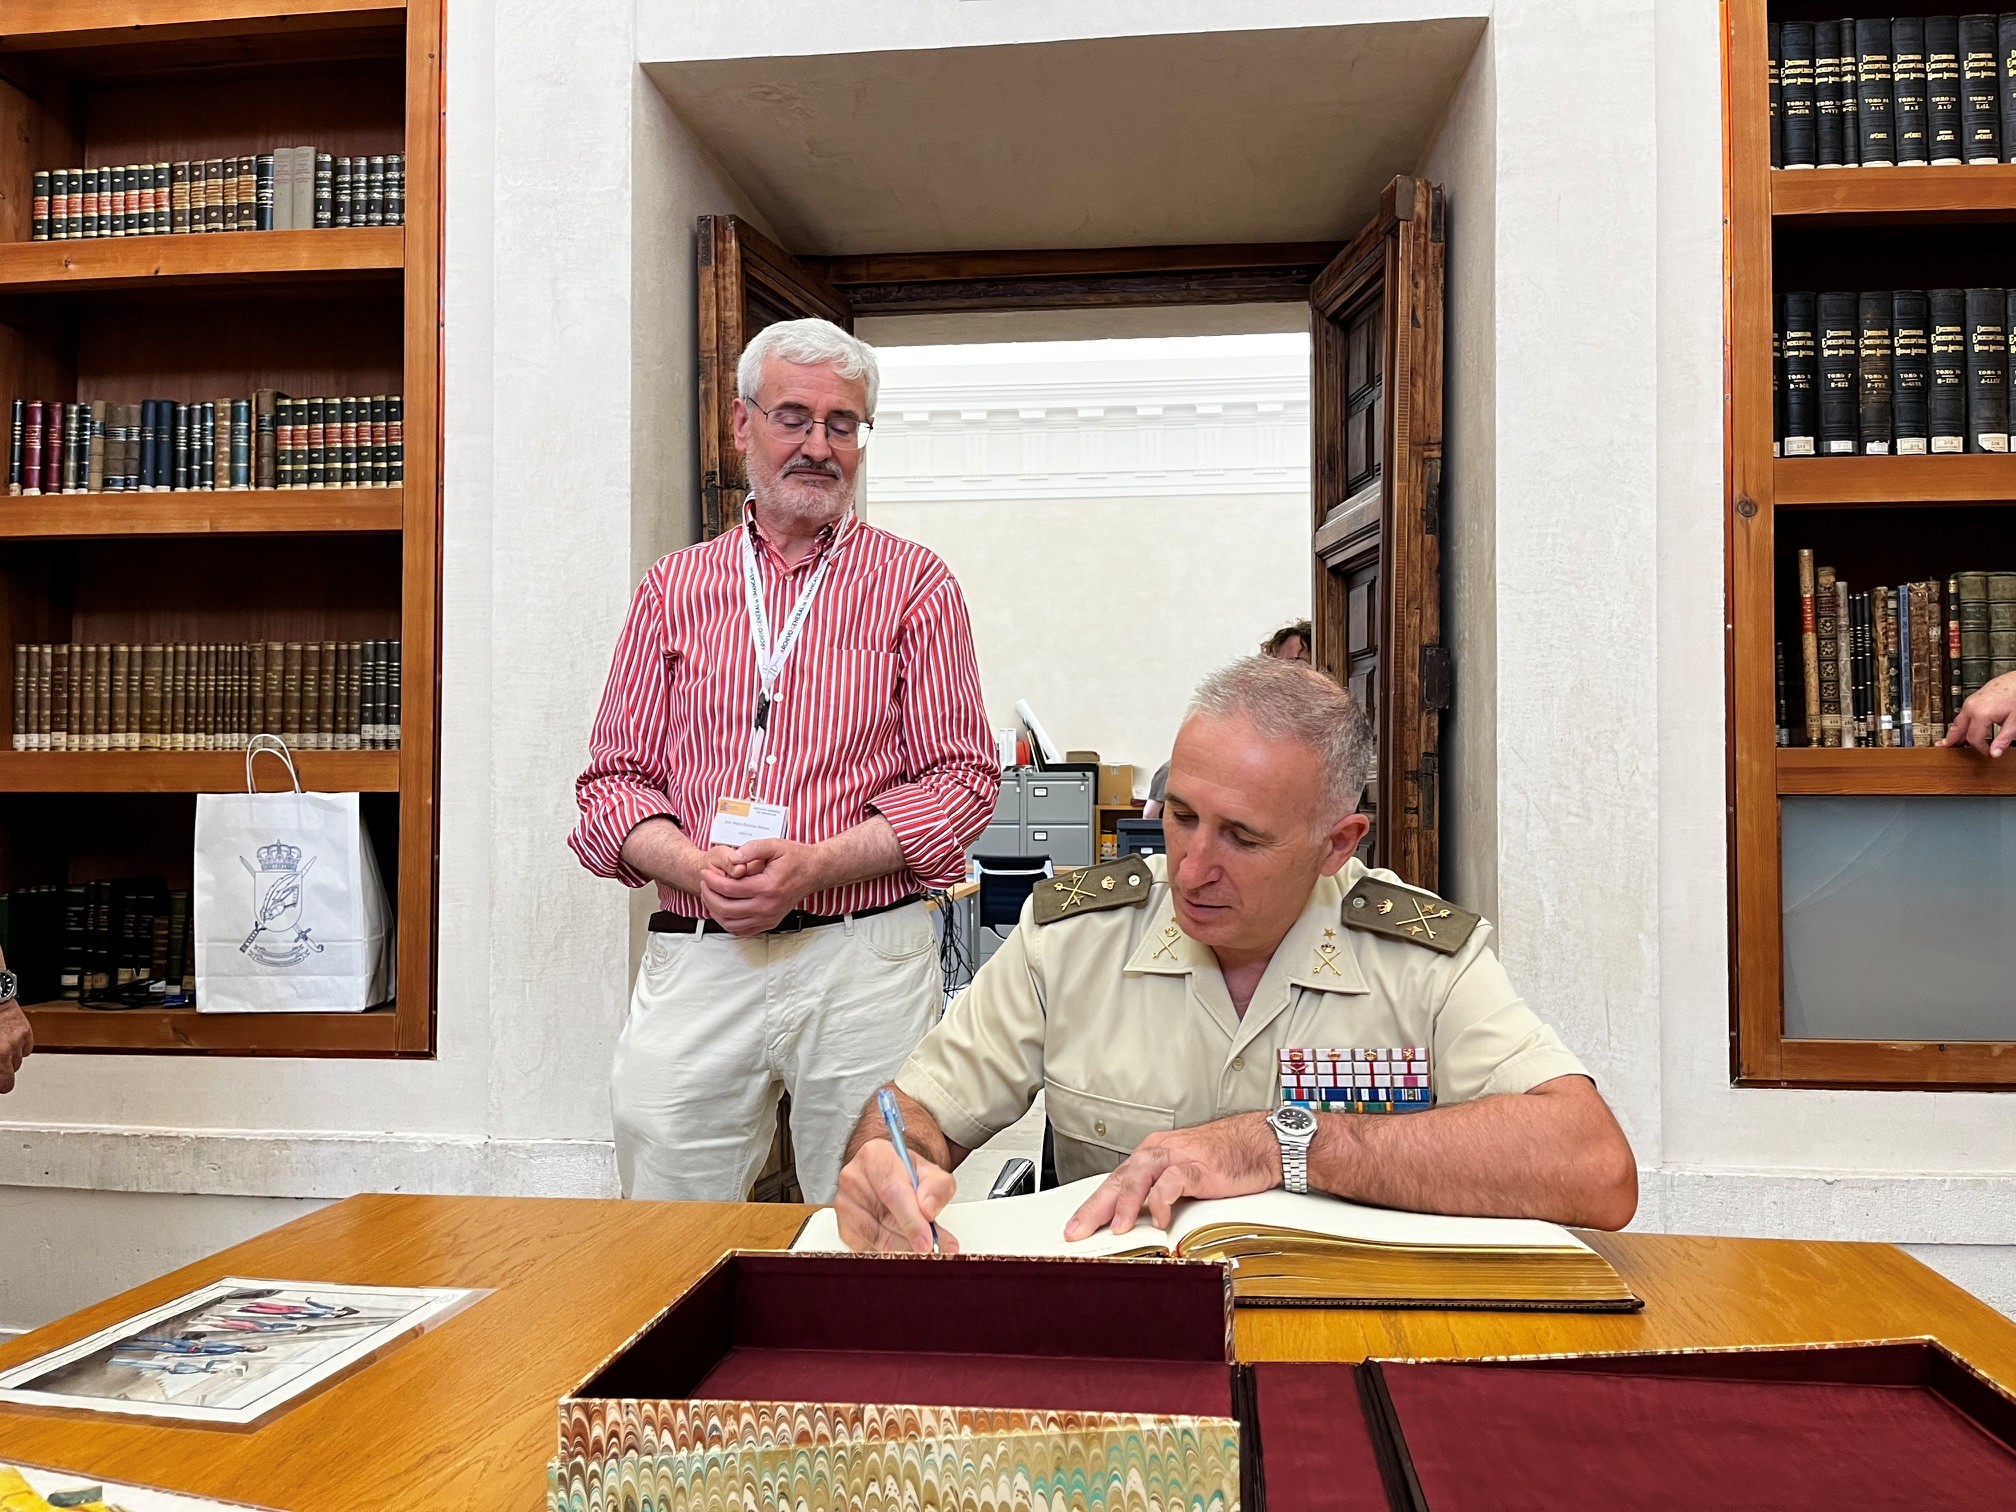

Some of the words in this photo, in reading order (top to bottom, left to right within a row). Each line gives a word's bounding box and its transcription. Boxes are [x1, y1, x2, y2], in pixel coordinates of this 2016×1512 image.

[754, 604, 762, 627] GENERAL
[758, 628, 766, 651] ARCHIVO
[780, 629, 793, 654] ARCHIVO
[790, 606, 804, 630] GENERAL
